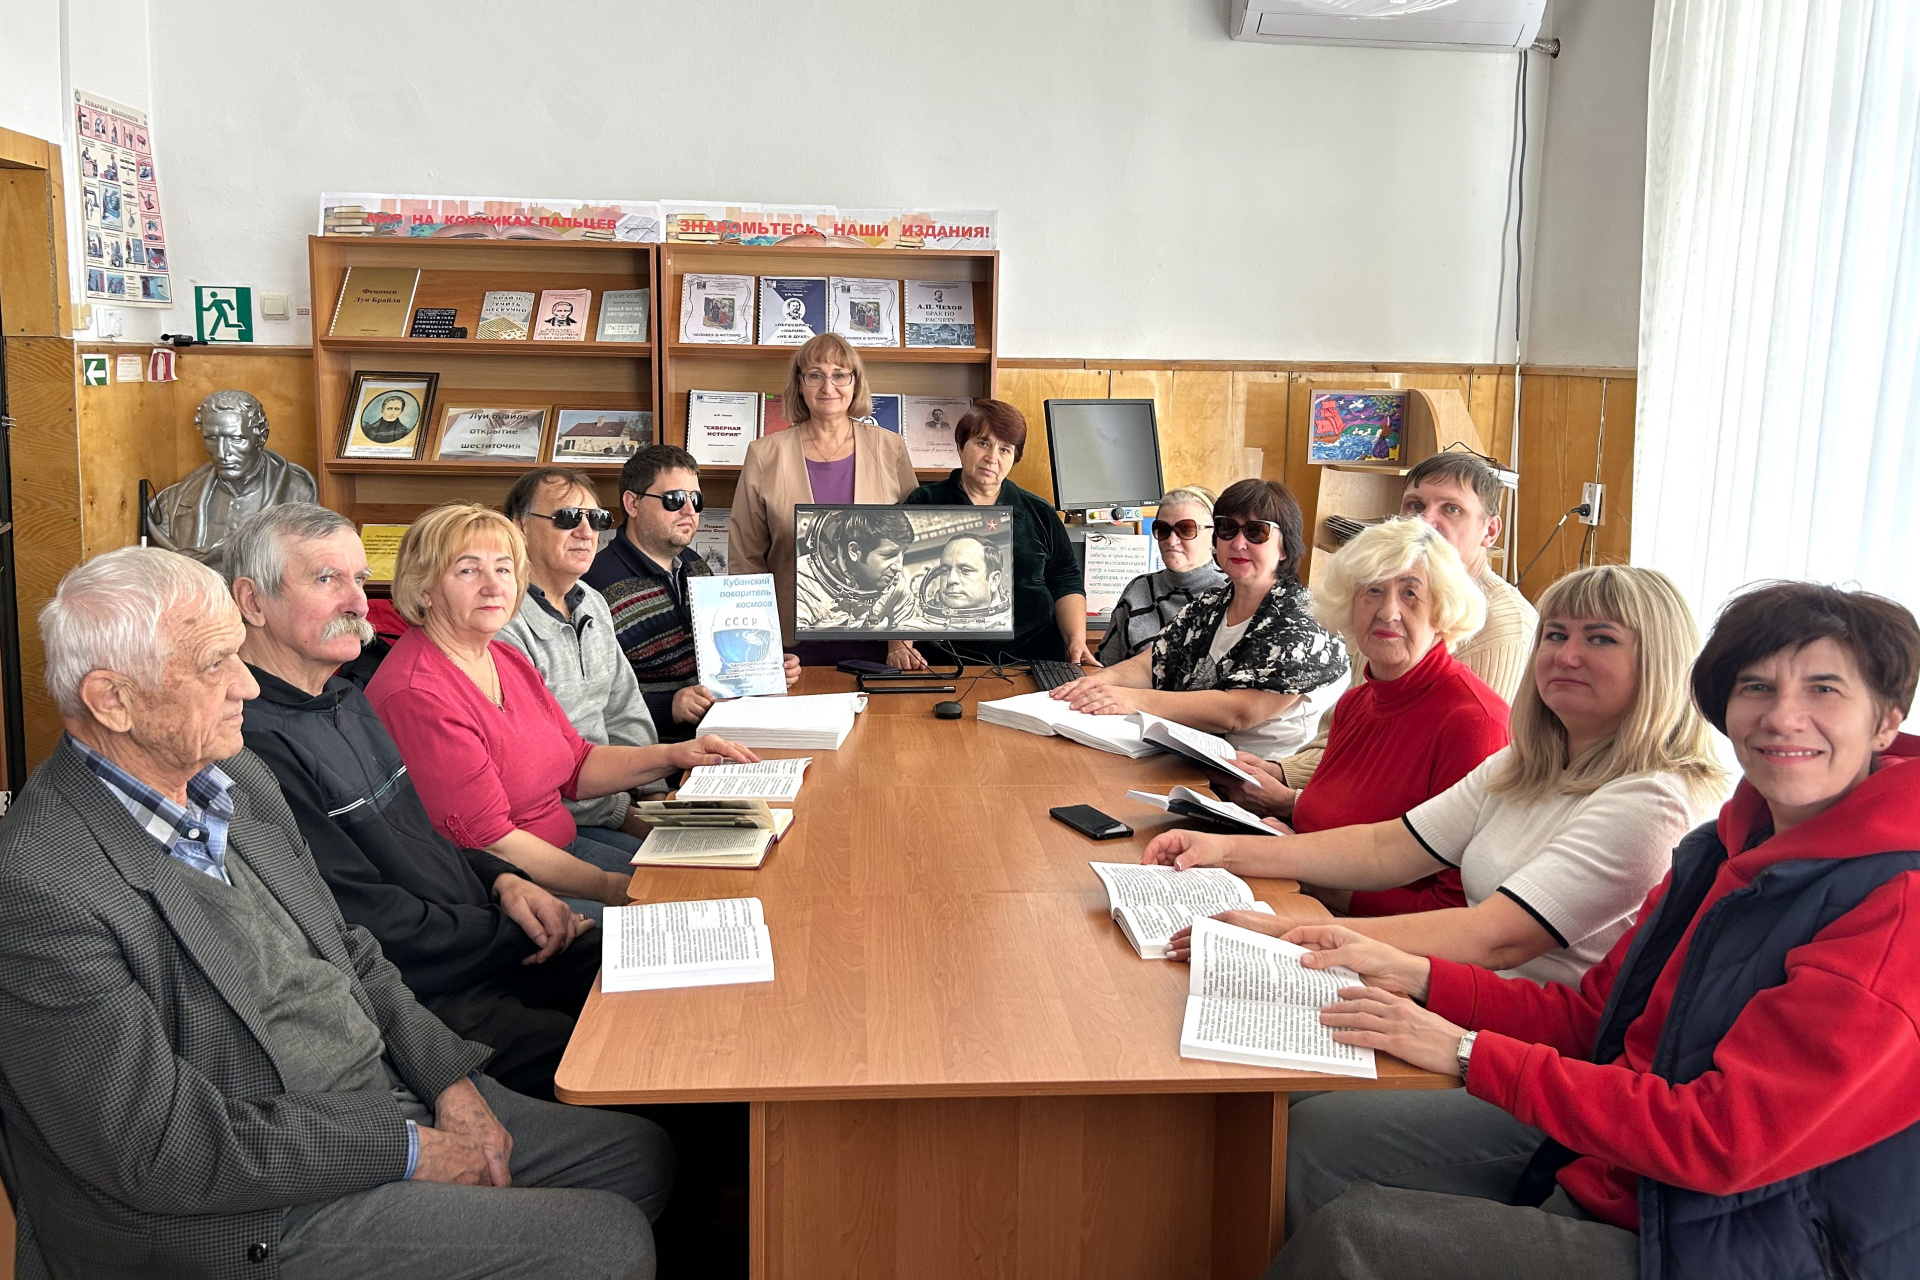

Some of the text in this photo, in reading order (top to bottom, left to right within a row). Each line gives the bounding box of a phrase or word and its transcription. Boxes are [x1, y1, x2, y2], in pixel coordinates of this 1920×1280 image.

[366, 212, 617, 230] МИР НА КОНЧИКАХ ПАЛЬЦЕВ
[680, 220, 990, 238] ЗНАКОМЬТЕСЬ, НАШИ ИЗДАНИЯ!
[469, 412, 489, 421] Луи
[724, 577, 770, 588] Кубанский
[720, 590, 771, 598] покоритель
[725, 617, 757, 626] СССР
